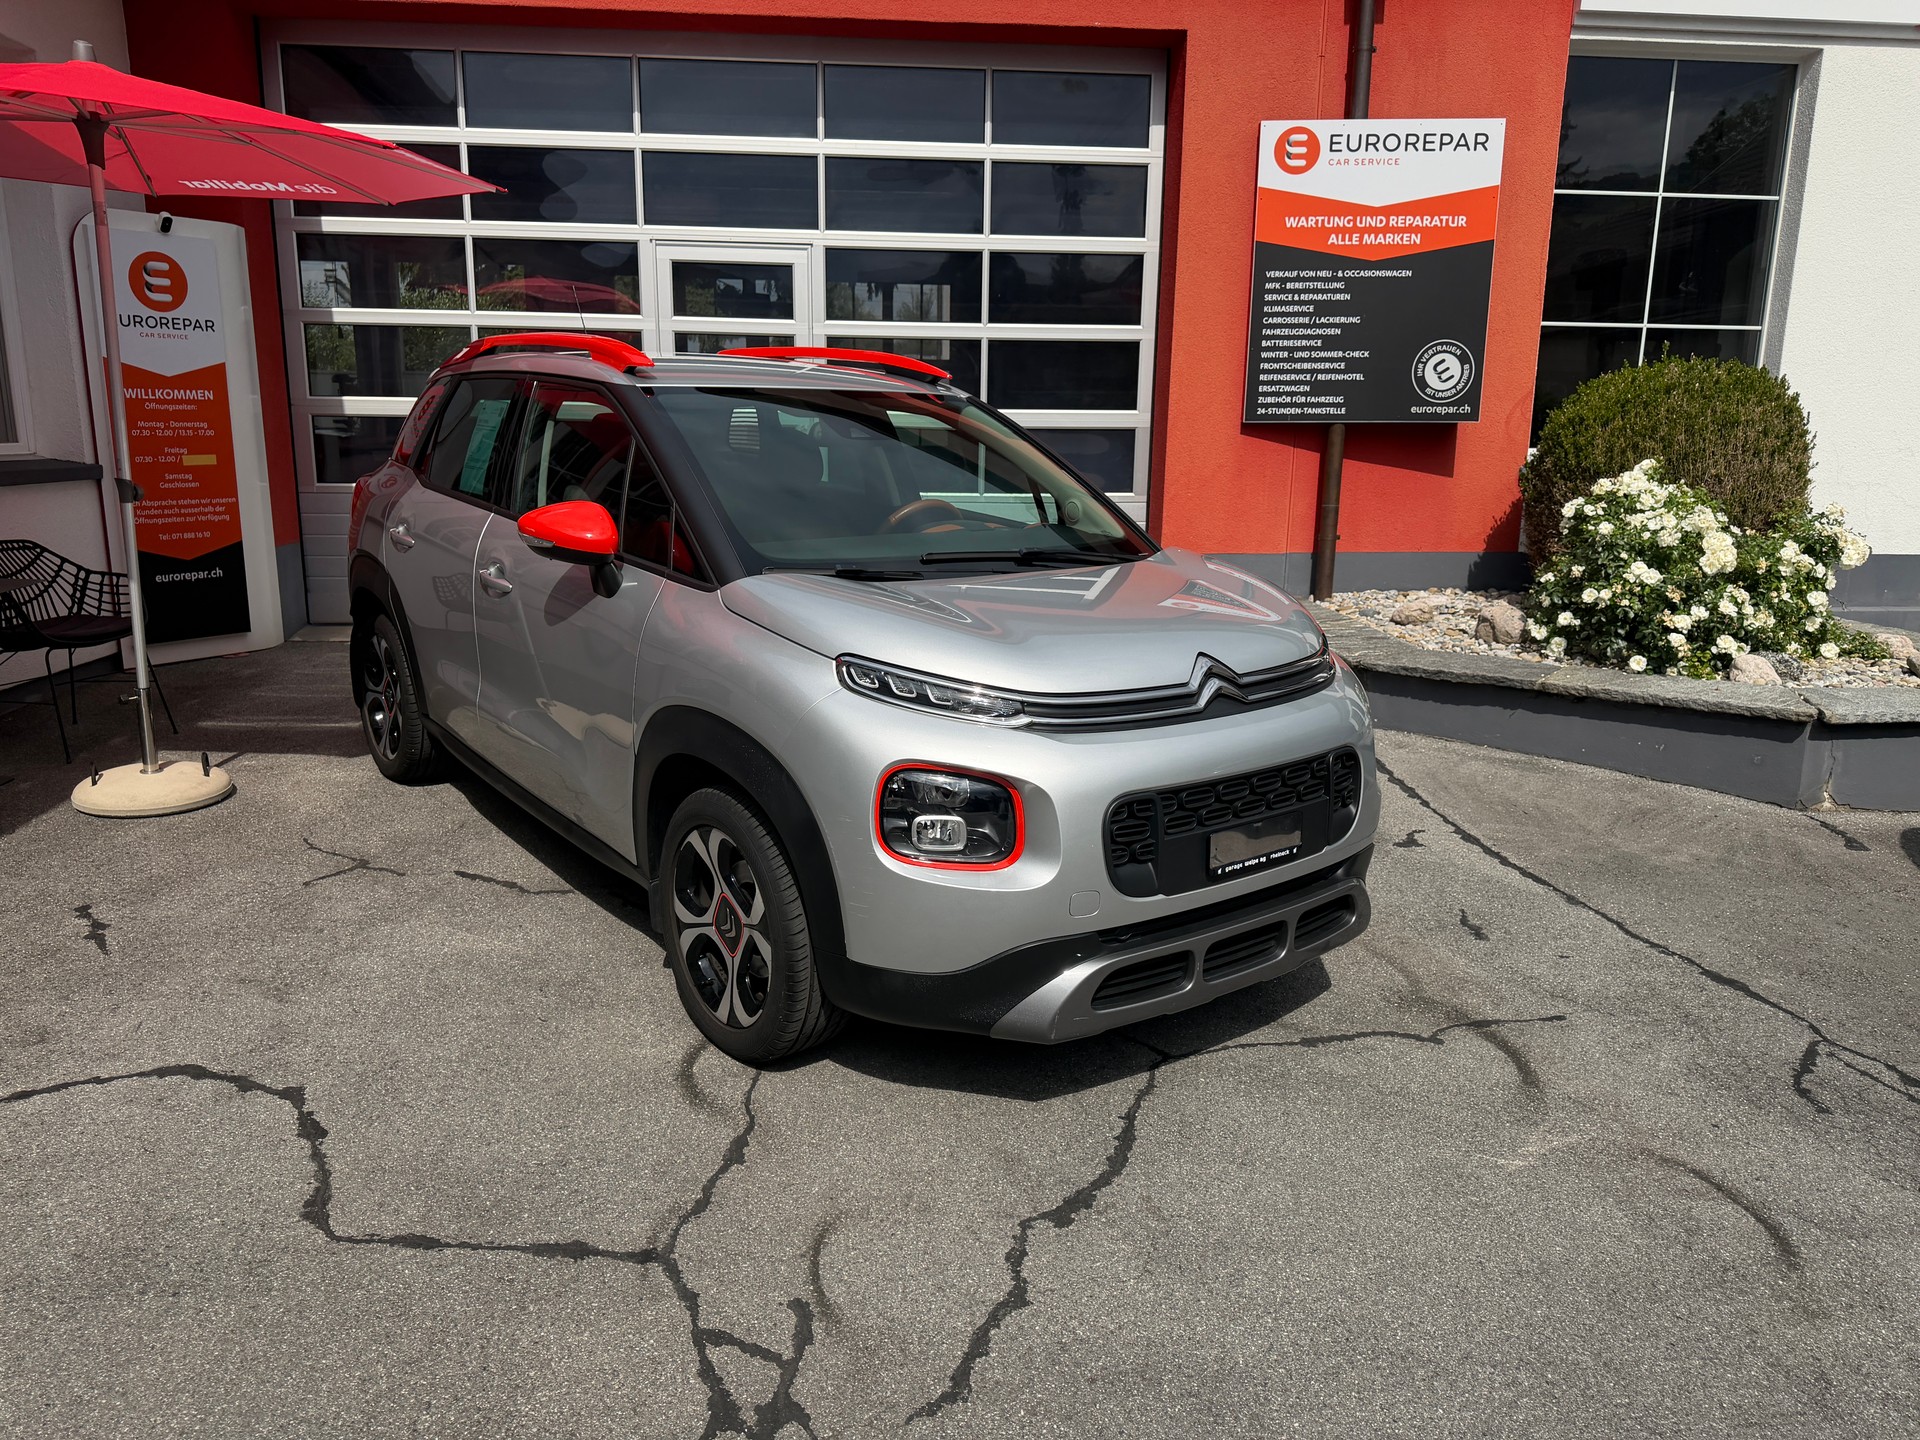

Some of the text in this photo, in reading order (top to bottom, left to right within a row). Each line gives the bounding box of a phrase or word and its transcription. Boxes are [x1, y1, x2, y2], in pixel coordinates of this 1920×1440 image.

[1328, 132, 1490, 153] EUROREPAR
[1328, 157, 1400, 166] CAR SERVICE
[1284, 215, 1467, 228] WARTUNG UND REPARATUR
[1327, 233, 1421, 245] ALLE MARKEN
[1265, 270, 1299, 278] VERKAUF
[1299, 270, 1316, 278] VON
[1316, 270, 1332, 278] NEU
[1286, 281, 1345, 289] BEREITSTELLUNG
[1300, 293, 1351, 301] REPARATUREN
[1263, 305, 1315, 313] KLIMASERVICE
[119, 313, 215, 333] UROREPAR
[1316, 316, 1361, 324] LACKIERUNG
[1262, 328, 1341, 336] FAHRZEUGDIAGNOSEN
[1311, 350, 1370, 358] SOMMER-CHECK
[1417, 344, 1462, 377] IHR VERTRAUEN
[1260, 362, 1346, 370] FRONTSCHEIBENSERVICE
[1259, 373, 1311, 381] REIFENSERVICE
[1317, 373, 1365, 381] REIFENHOTEL
[1424, 363, 1470, 398] IST UNSER ANTRIEB
[123, 387, 214, 400] WILLKOMMEN
[1257, 395, 1291, 403] ZUBEHÖR
[1292, 395, 1306, 403] FÜR
[144, 401, 198, 411] Öffnungszeiten:
[1410, 403, 1471, 416] eurorepar.ch
[1256, 407, 1346, 415] 24-STUNDEN-TANKSTELLE
[137, 421, 165, 429] Montag
[169, 420, 208, 429] Donnerstag
[141, 499, 177, 507] Absprache
[136, 508, 163, 516] Kunden
[180, 505, 214, 513] ausserhalb
[134, 515, 185, 525] Öffnungszeiten
[196, 514, 230, 523] Verfügung
[155, 567, 223, 583] eurorepar.ch
[1225, 862, 1243, 873] garage
